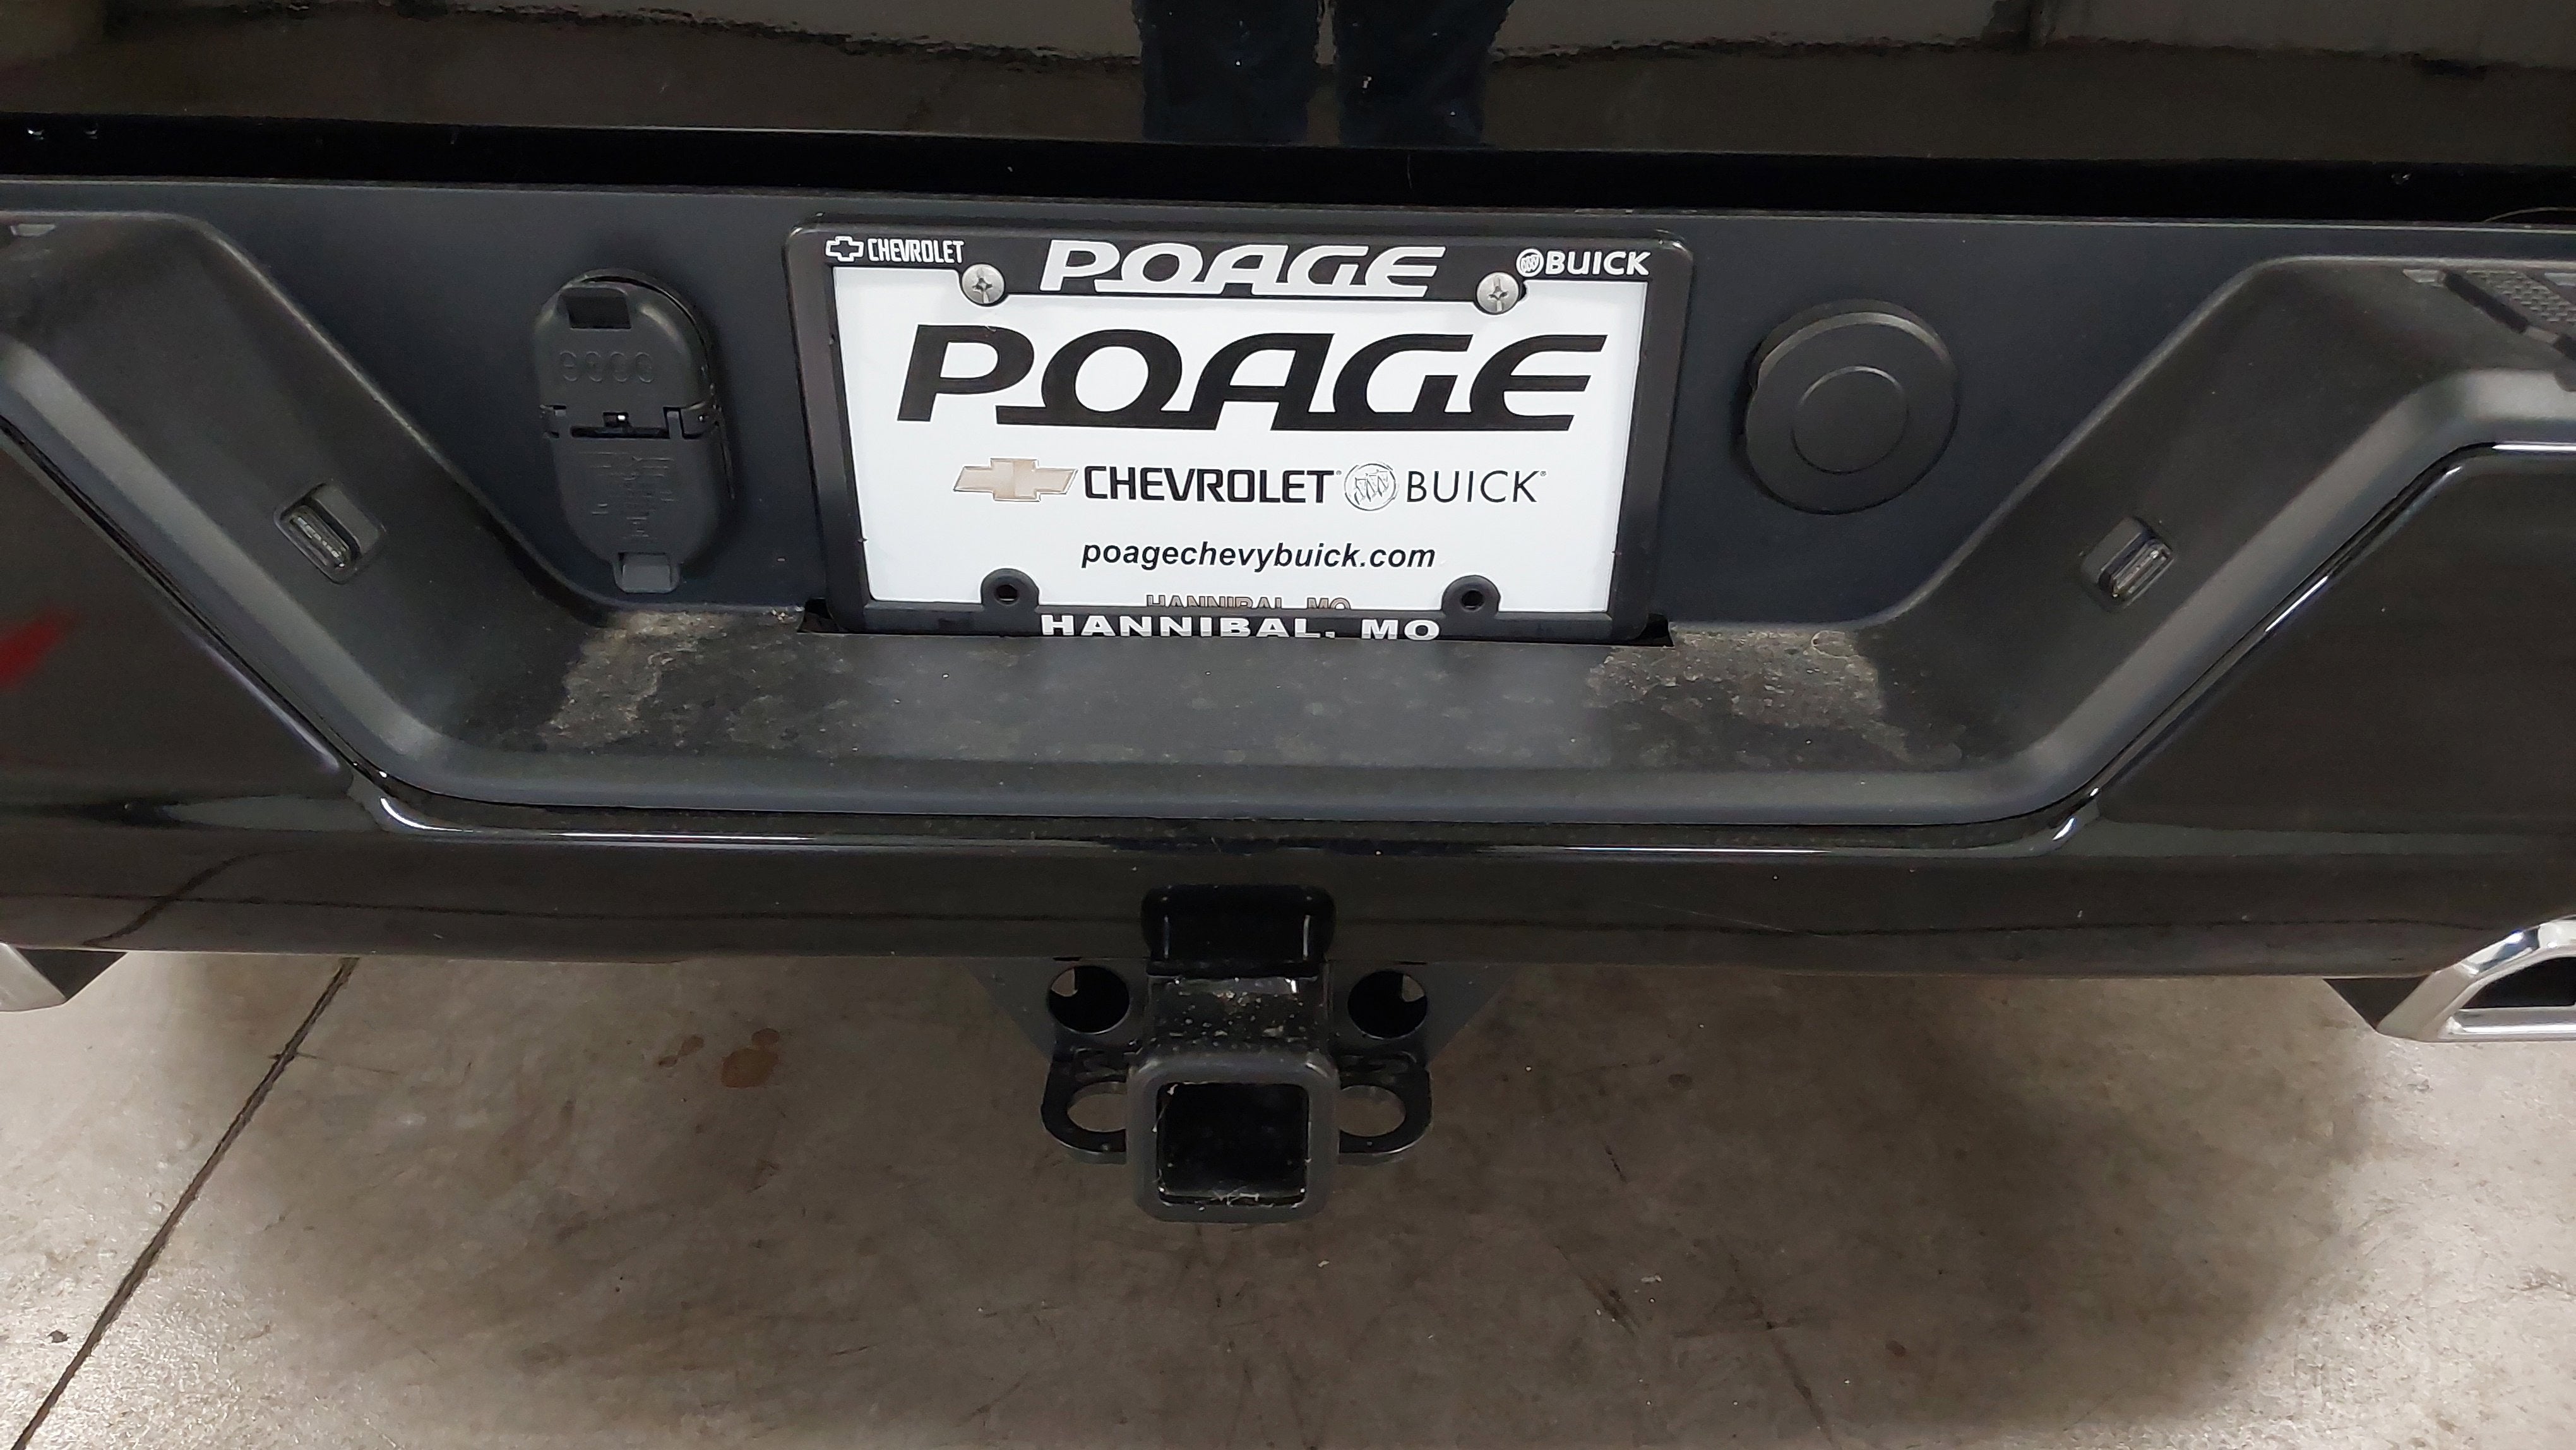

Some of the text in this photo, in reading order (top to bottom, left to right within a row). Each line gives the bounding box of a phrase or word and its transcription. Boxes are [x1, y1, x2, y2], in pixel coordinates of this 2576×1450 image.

[868, 238, 964, 263] CHEVROLET
[1546, 251, 1650, 276] BUICK
[1041, 240, 1446, 297] POAGE
[897, 324, 1607, 431] POAGE
[1081, 541, 1436, 573] poagechevybuick.com
[1361, 620, 1441, 640] MO
